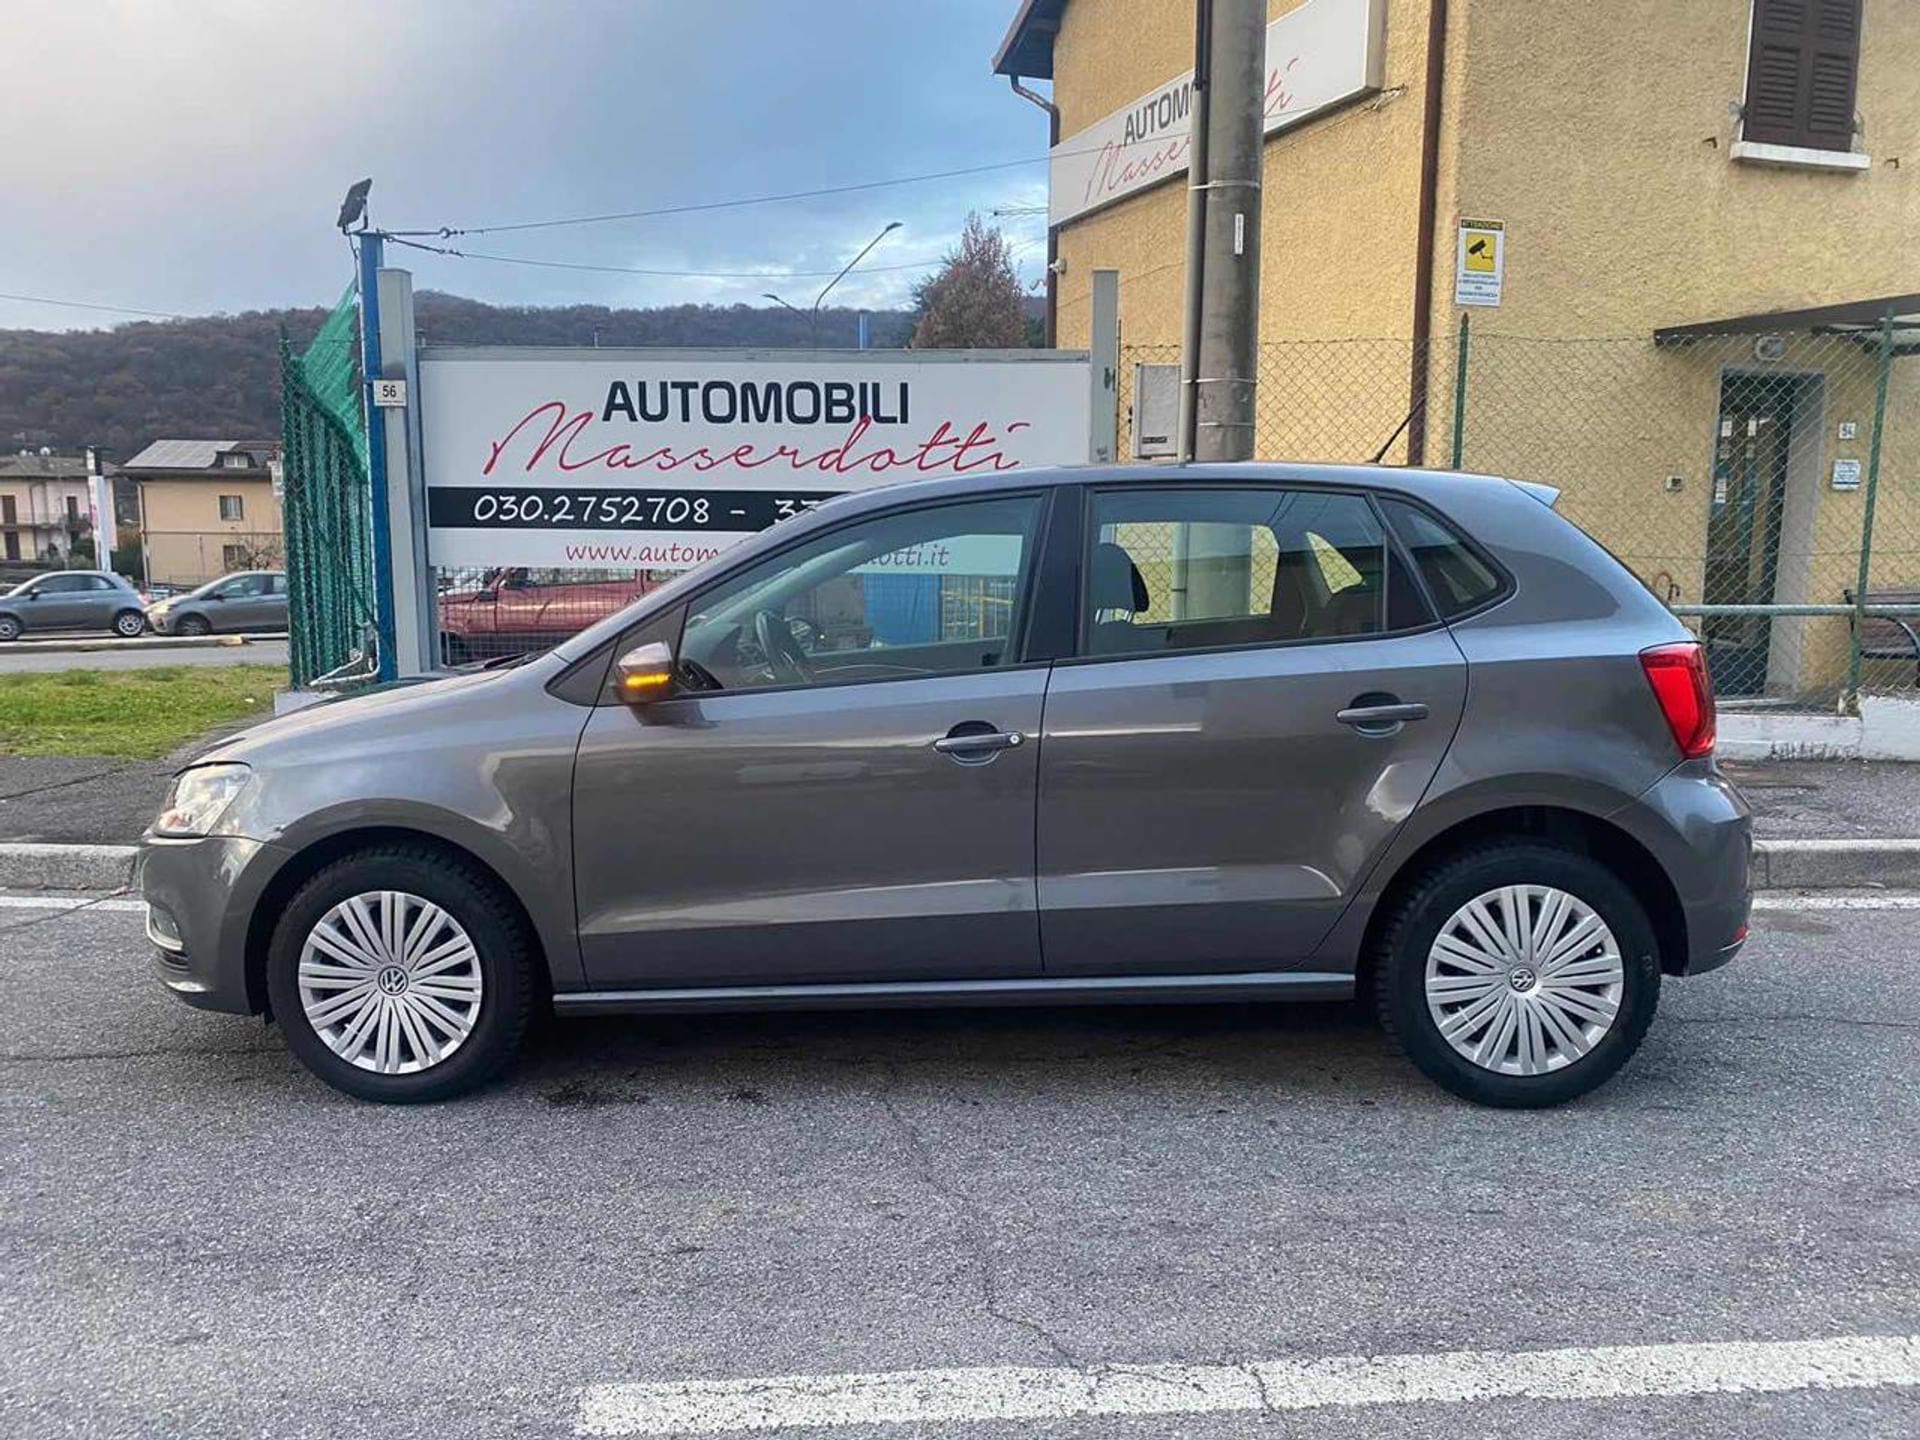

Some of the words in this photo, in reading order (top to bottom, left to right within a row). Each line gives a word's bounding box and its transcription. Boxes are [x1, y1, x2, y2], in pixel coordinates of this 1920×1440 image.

[1124, 81, 1197, 147] AUTOM
[1084, 135, 1192, 205] Masse
[382, 385, 397, 398] 56
[601, 380, 910, 425] AUTOMOBILI
[482, 400, 1030, 476] Masserdotti
[473, 494, 711, 524] 030.2752708
[866, 544, 950, 567] otti.it
